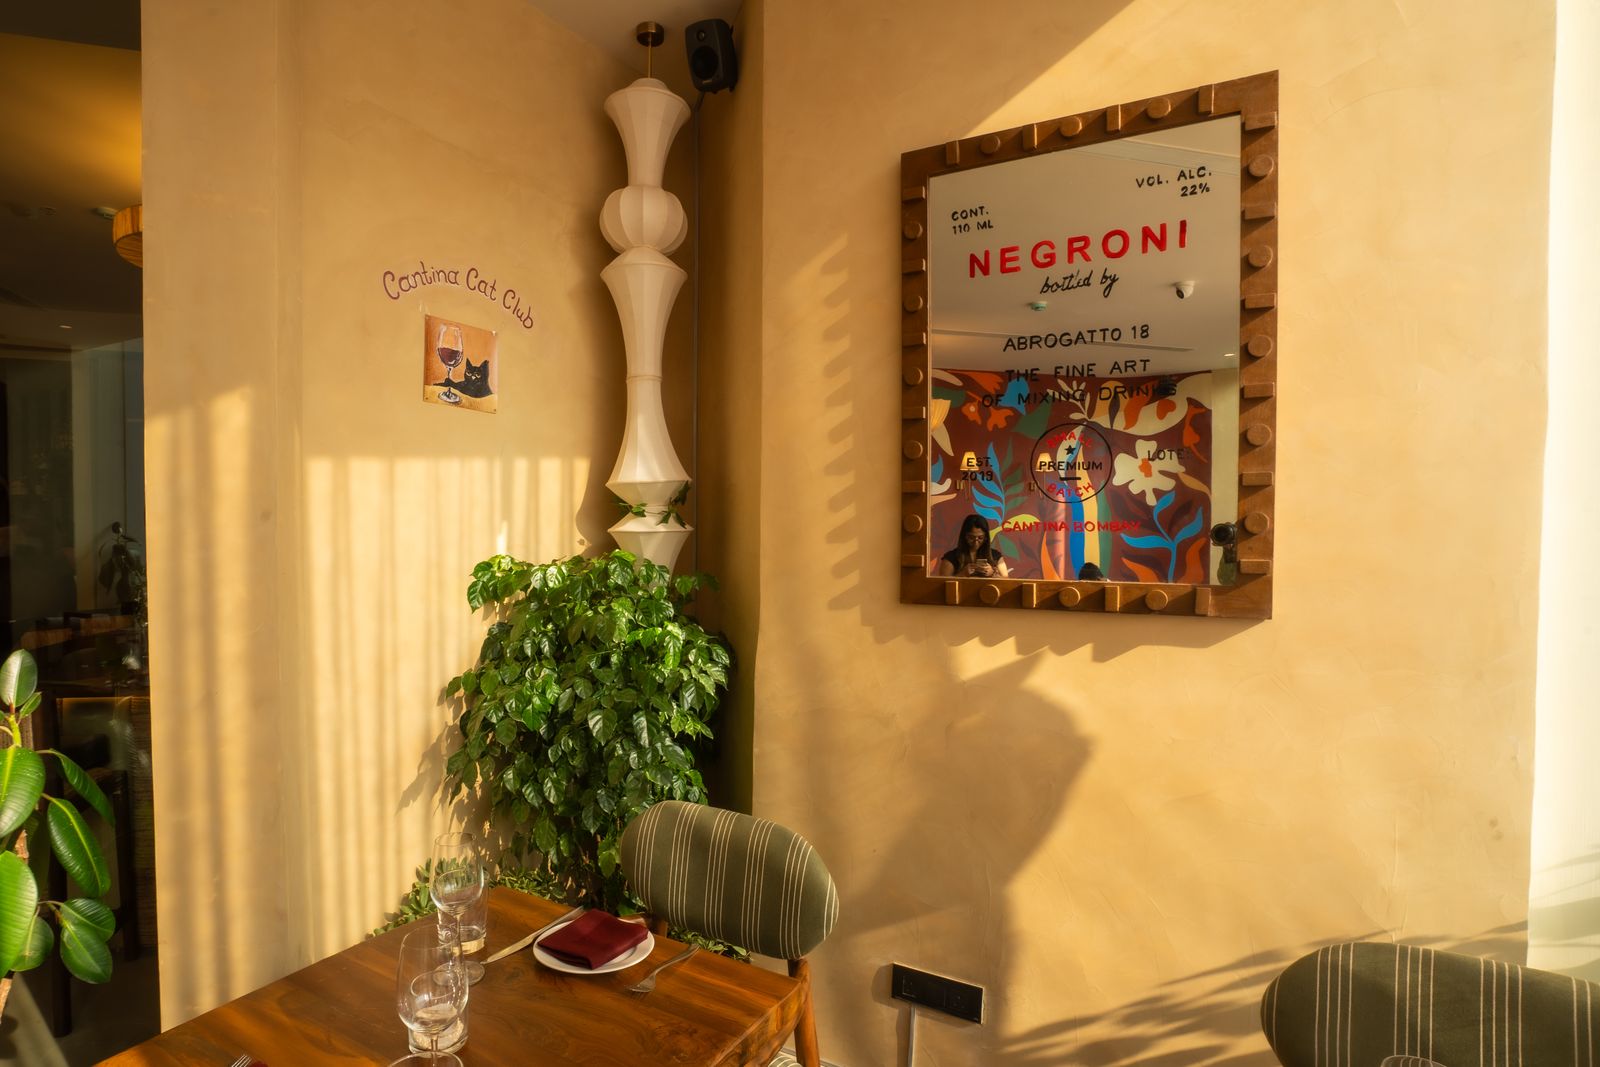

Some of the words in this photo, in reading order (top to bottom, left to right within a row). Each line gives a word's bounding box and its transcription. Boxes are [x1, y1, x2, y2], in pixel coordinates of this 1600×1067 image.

[1135, 174, 1169, 188] VOL.
[1177, 166, 1212, 181] ALC.
[1180, 182, 1210, 197] 22%
[951, 205, 989, 221] CONT.
[952, 223, 970, 235] 110
[976, 219, 994, 231] ML
[968, 219, 1188, 279] NEGRONI
[1099, 267, 1119, 298] by
[382, 261, 460, 300] Cantina
[466, 267, 497, 301] Cat
[502, 289, 534, 329] Club
[1003, 327, 1122, 352] ABROGATTO
[1131, 324, 1150, 340] 18
[1005, 368, 1041, 383] THE
[1053, 362, 1098, 379] FINE
[1109, 358, 1151, 375] ART
[981, 393, 1006, 409] OF
[1017, 387, 1087, 407] MIXING
[966, 456, 993, 468] EST.
[1039, 461, 1103, 471] PREMIUM
[961, 470, 994, 482] 2019
[1001, 520, 1070, 533] CANTINA
[1073, 520, 1141, 533] BOMBAY
